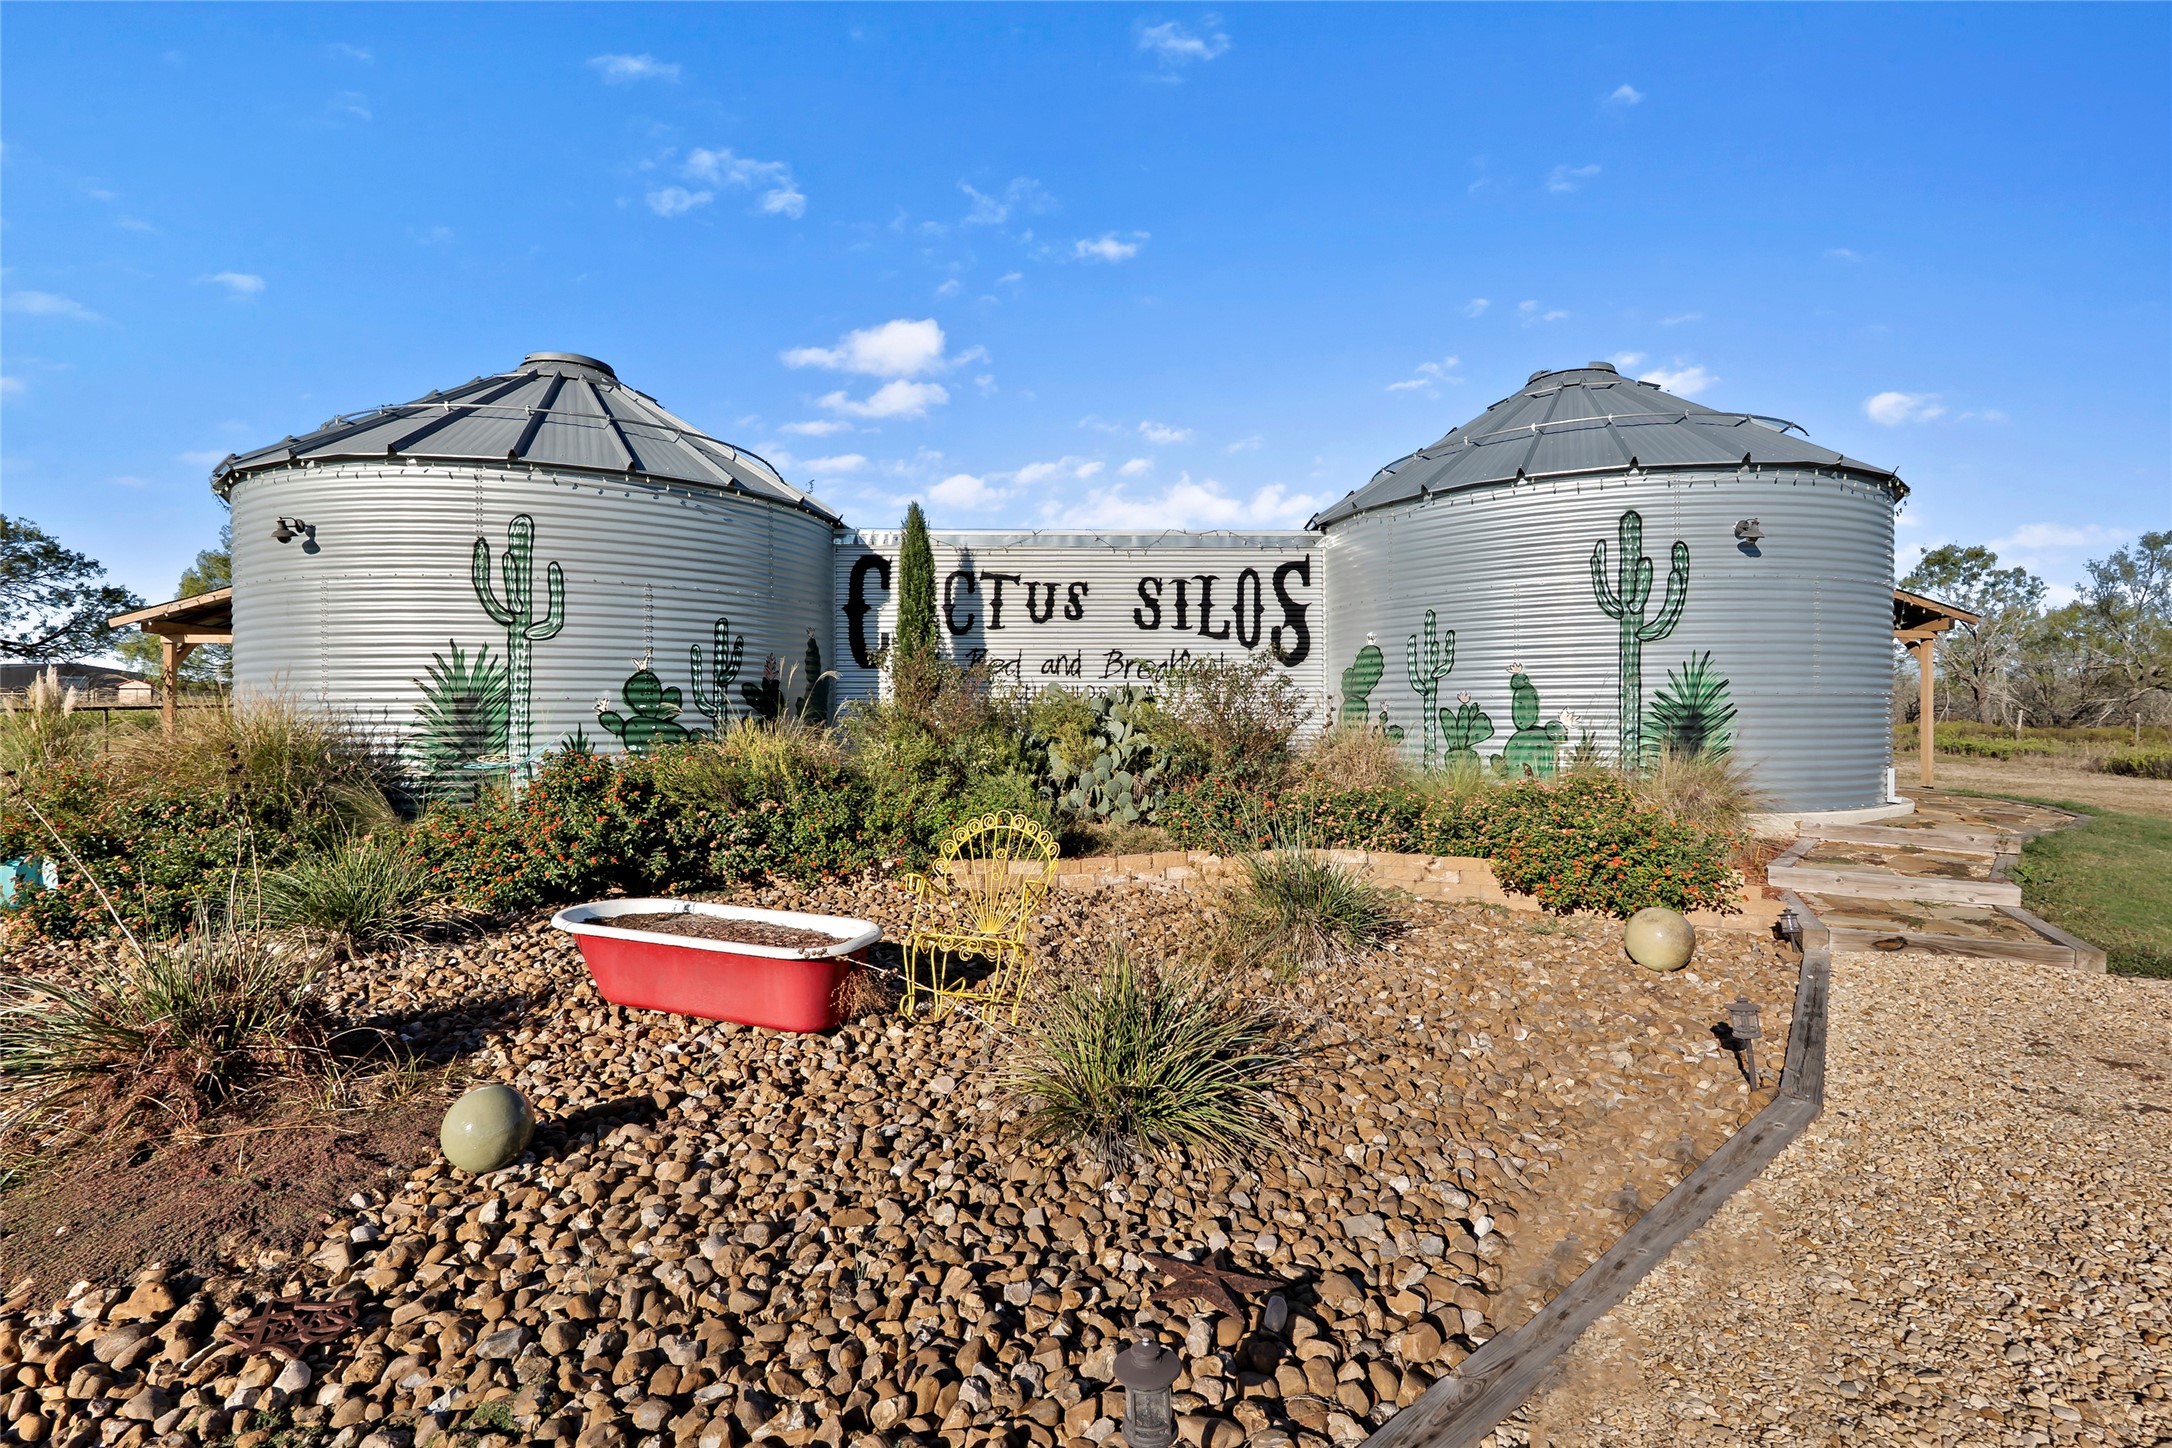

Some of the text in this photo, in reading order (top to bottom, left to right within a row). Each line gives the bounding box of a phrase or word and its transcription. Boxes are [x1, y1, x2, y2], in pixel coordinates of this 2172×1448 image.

[841, 553, 1312, 669] CCTUS SILOS
[1041, 648, 1081, 679] and
